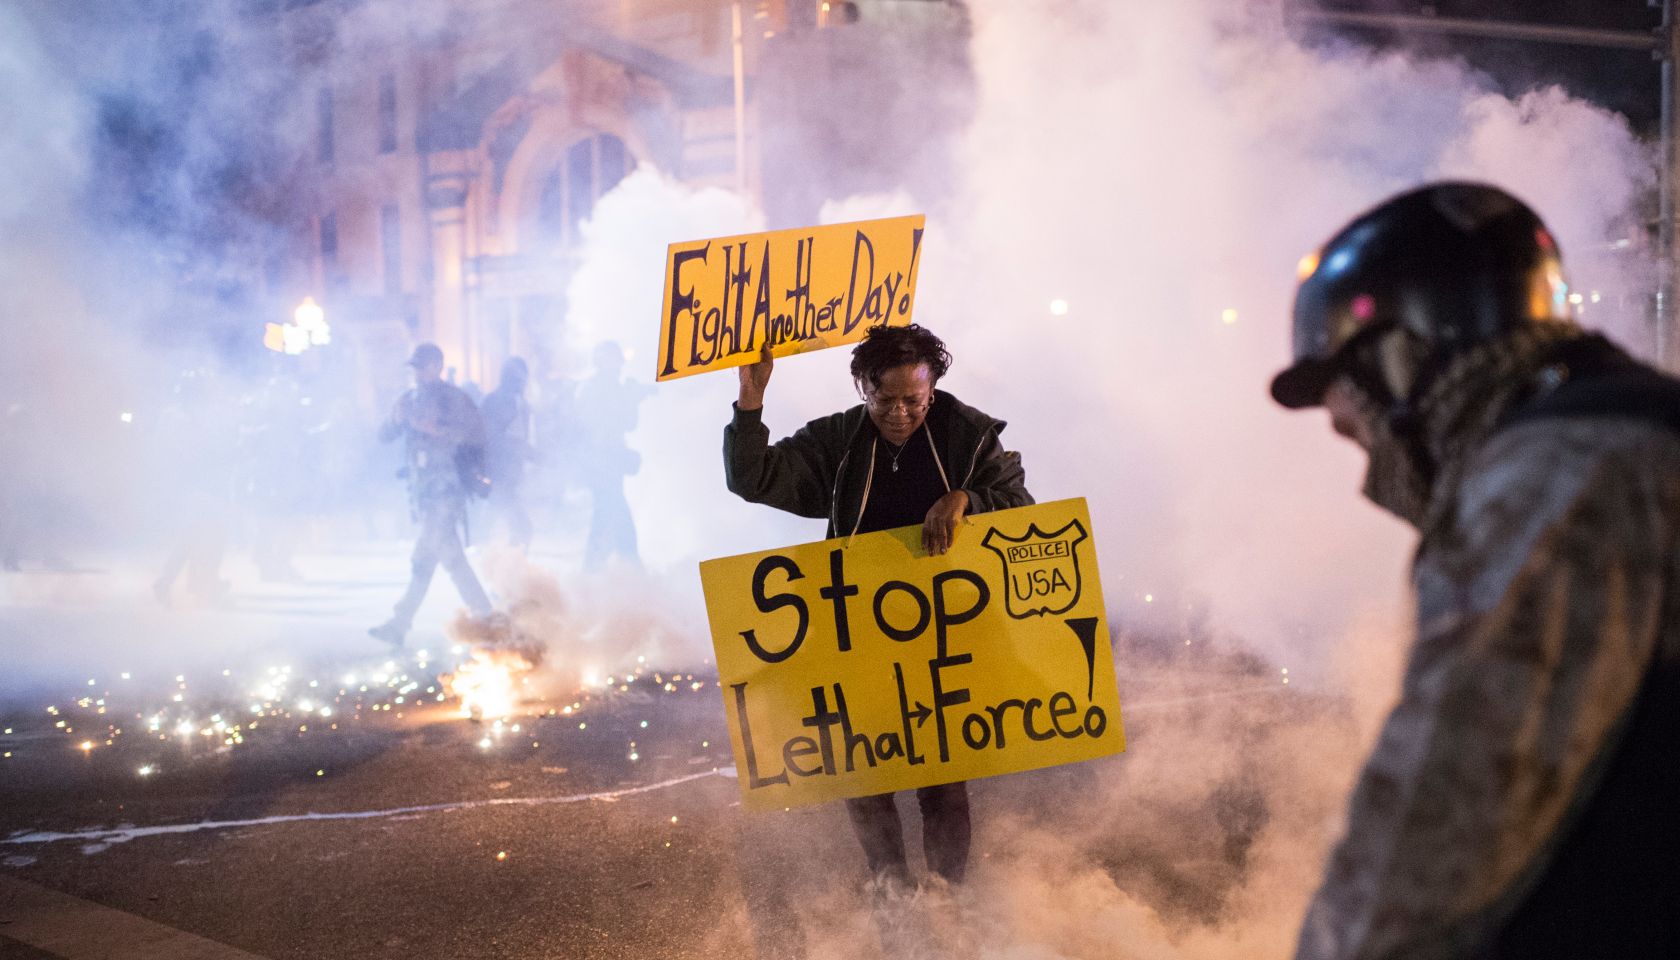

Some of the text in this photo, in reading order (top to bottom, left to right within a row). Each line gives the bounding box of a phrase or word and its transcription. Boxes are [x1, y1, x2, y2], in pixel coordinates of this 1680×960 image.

[660, 228, 924, 377] Fight Another Day!
[1011, 542, 1065, 561] POLICE
[1012, 567, 1072, 601] USA
[730, 616, 1107, 790] Lethal Force!
